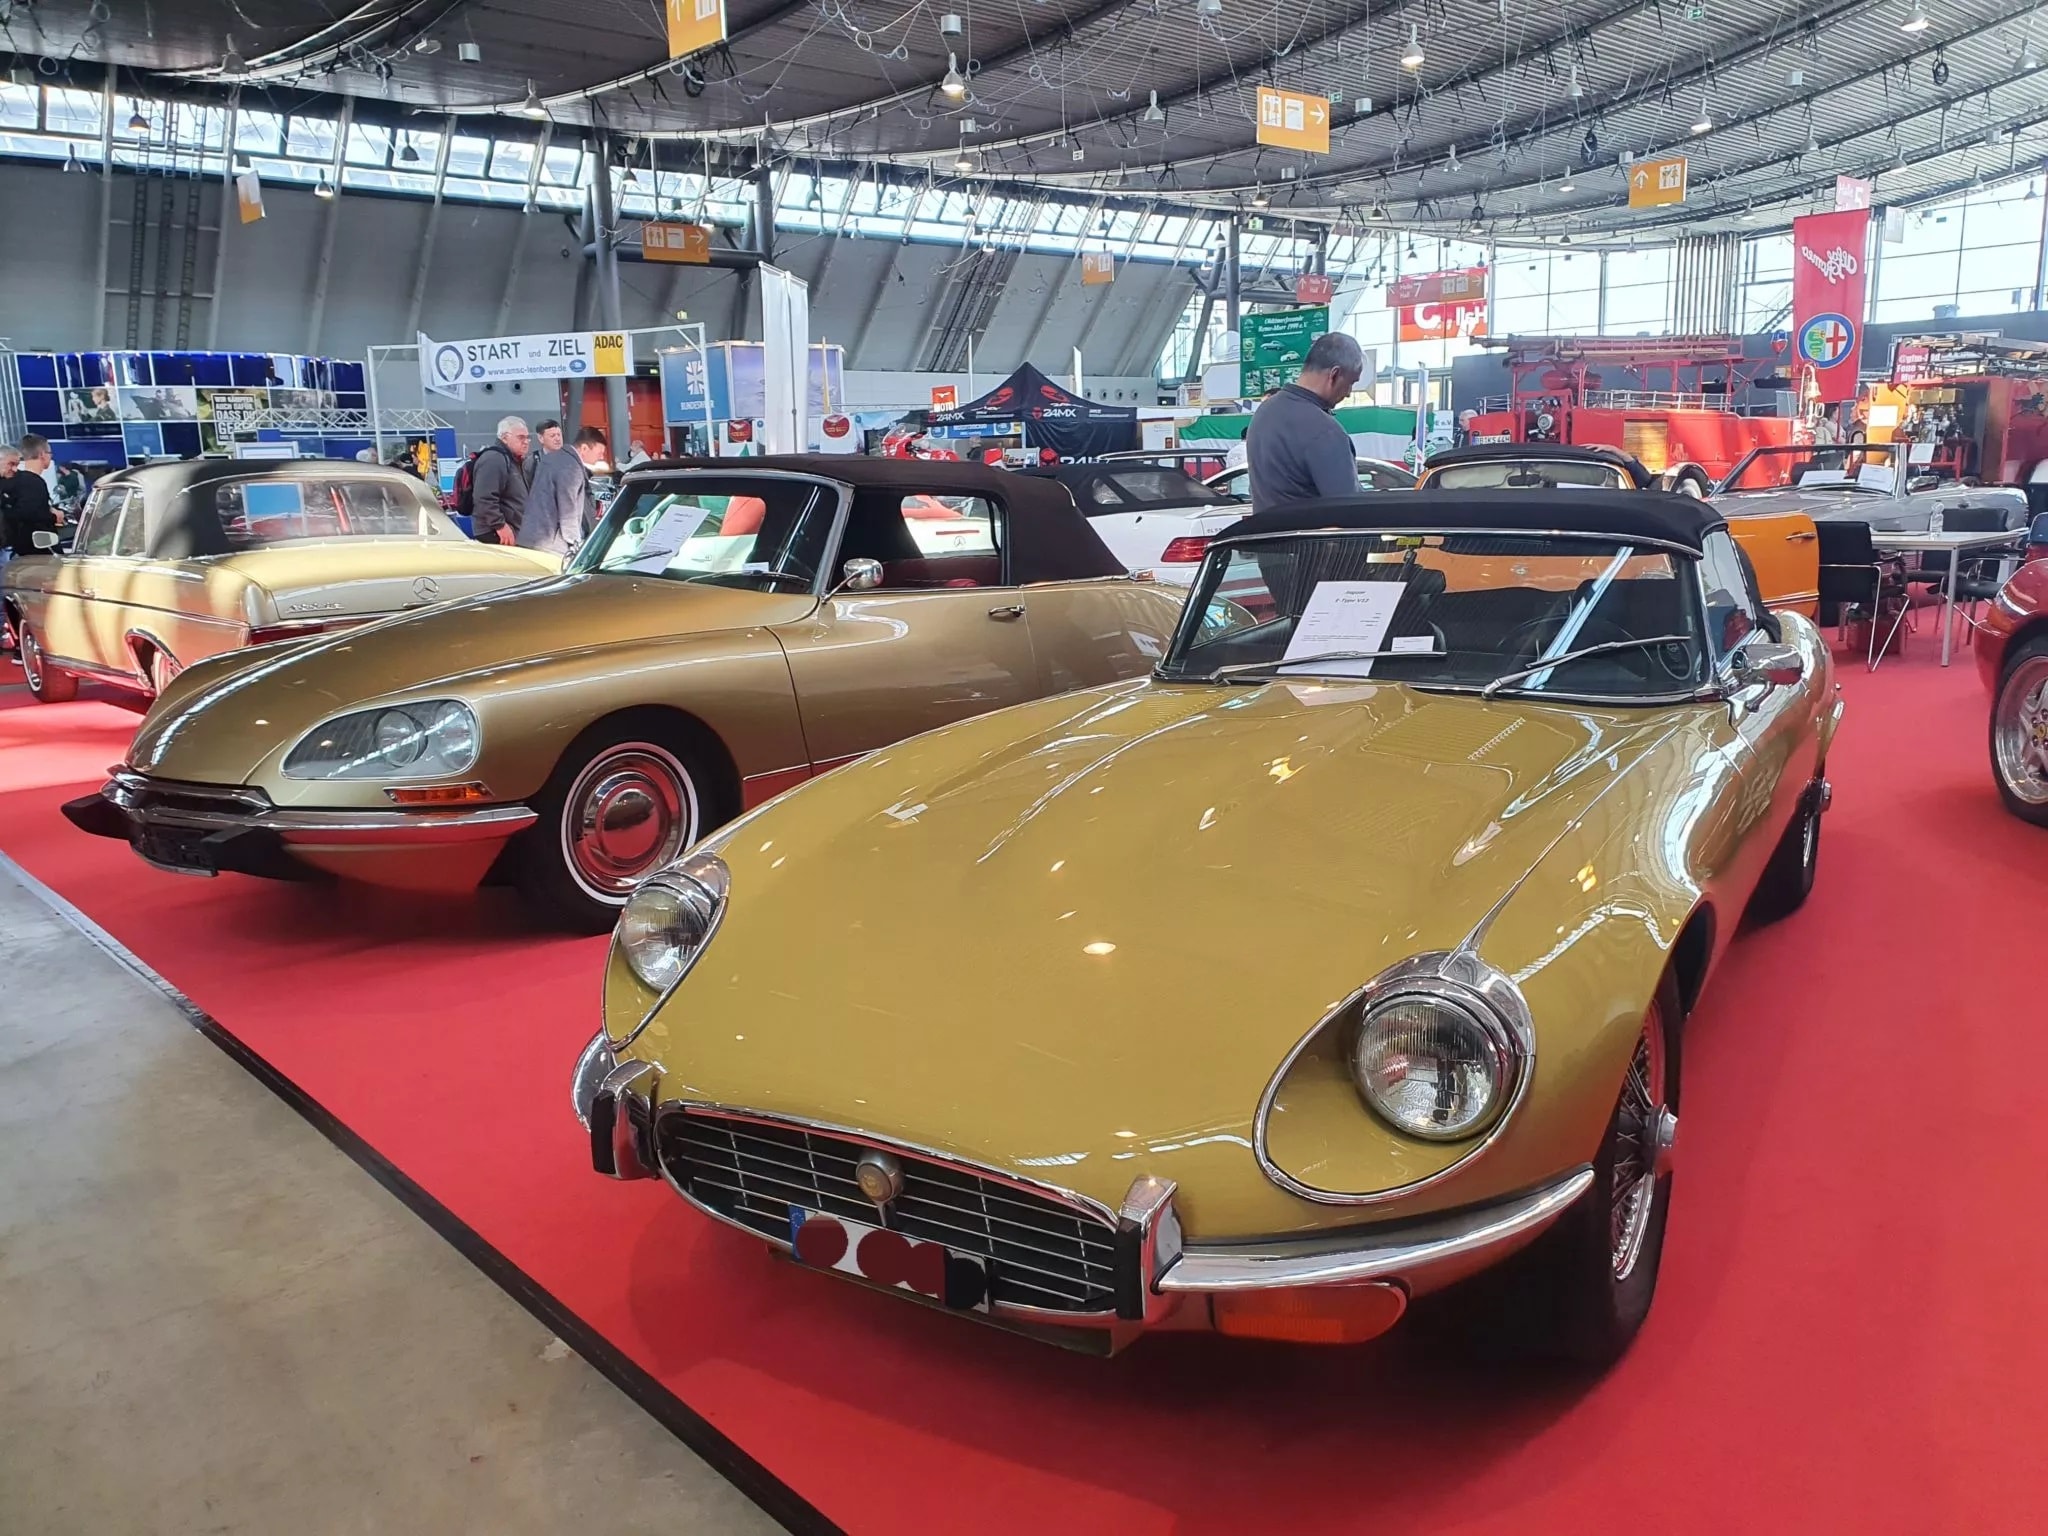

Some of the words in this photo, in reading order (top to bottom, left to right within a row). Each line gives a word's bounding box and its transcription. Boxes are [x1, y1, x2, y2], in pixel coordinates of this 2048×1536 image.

[1855, 186, 1863, 207] 5
[1321, 278, 1329, 294] 7
[1413, 282, 1422, 297] 7
[467, 342, 521, 362] START
[528, 350, 541, 358] und
[548, 338, 586, 356] ZIEL
[594, 335, 623, 349] ADAC
[216, 410, 241, 420] DASS
[936, 411, 965, 422] 24MX
[1042, 408, 1077, 418] 24MX
